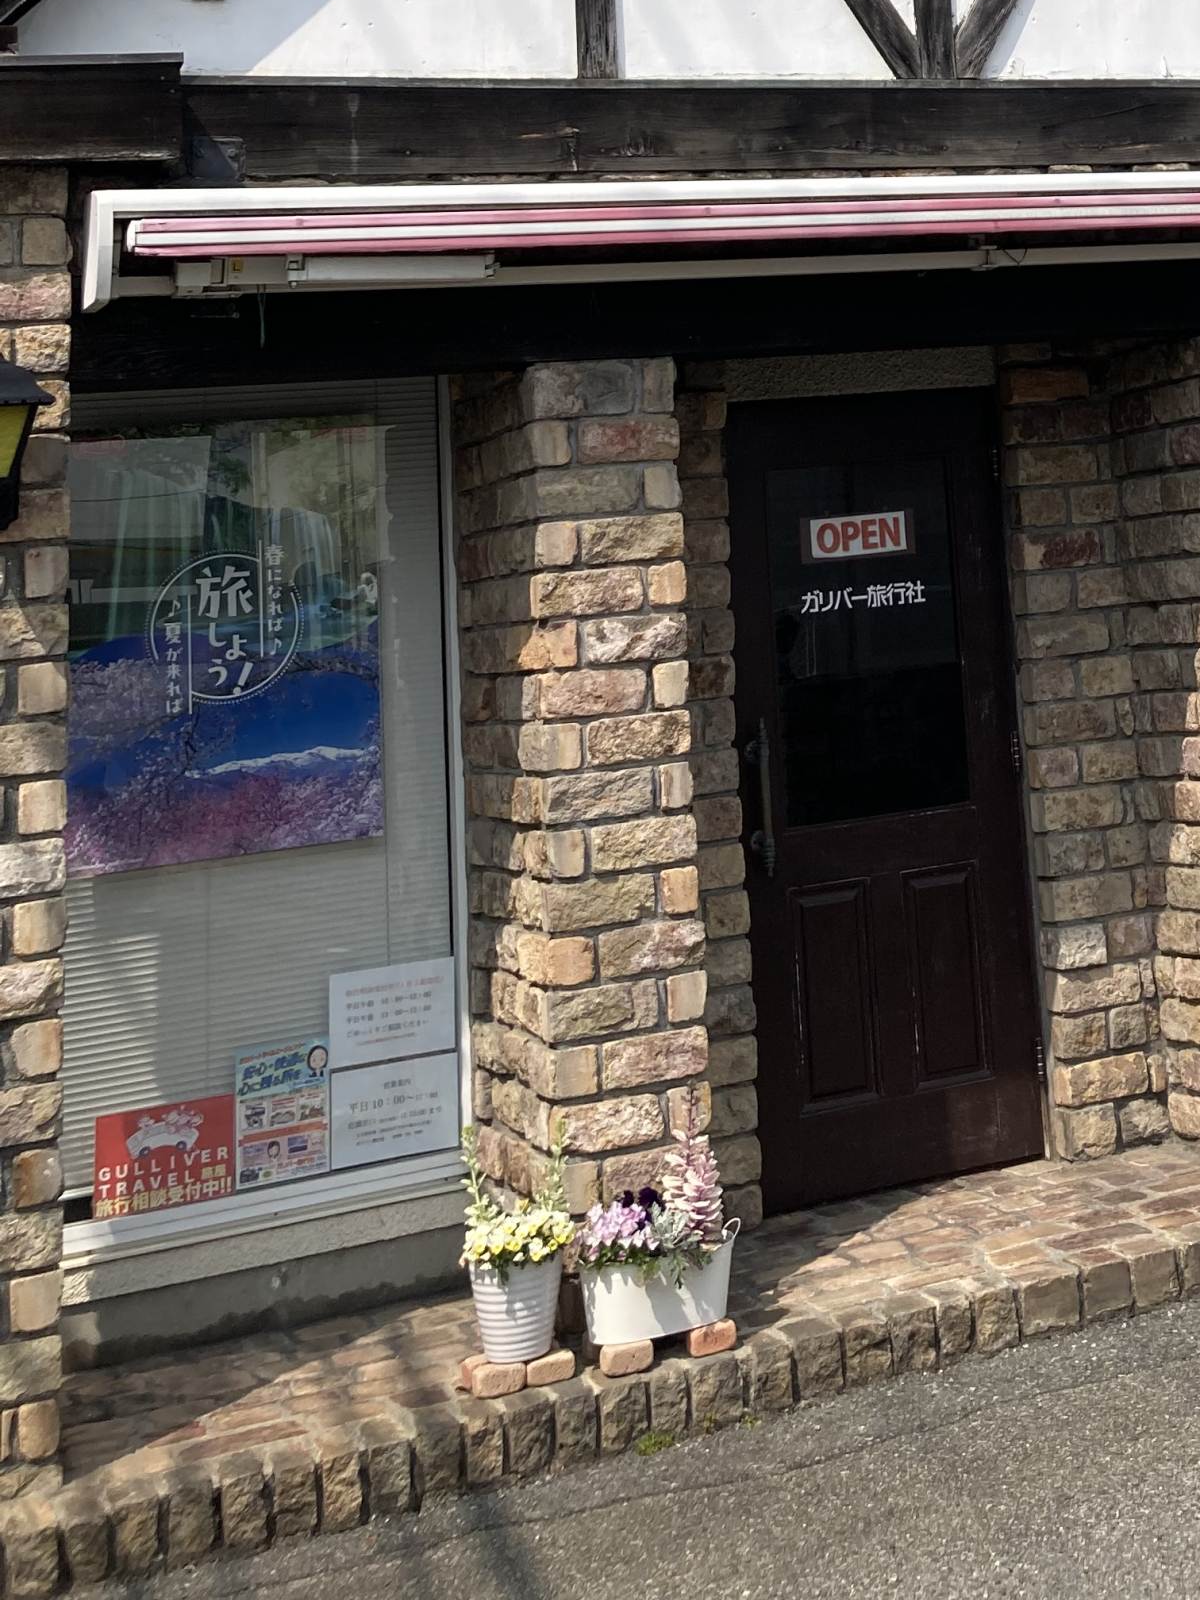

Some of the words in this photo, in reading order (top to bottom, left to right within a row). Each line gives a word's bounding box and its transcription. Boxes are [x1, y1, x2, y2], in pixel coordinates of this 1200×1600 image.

[816, 516, 901, 554] OPEN
[801, 580, 926, 614] ガリバー旅行社
[98, 1146, 229, 1182] GULLIVER
[95, 1176, 232, 1218] 旅行相談受付中!!
[98, 1170, 195, 1199] TRAVEL
